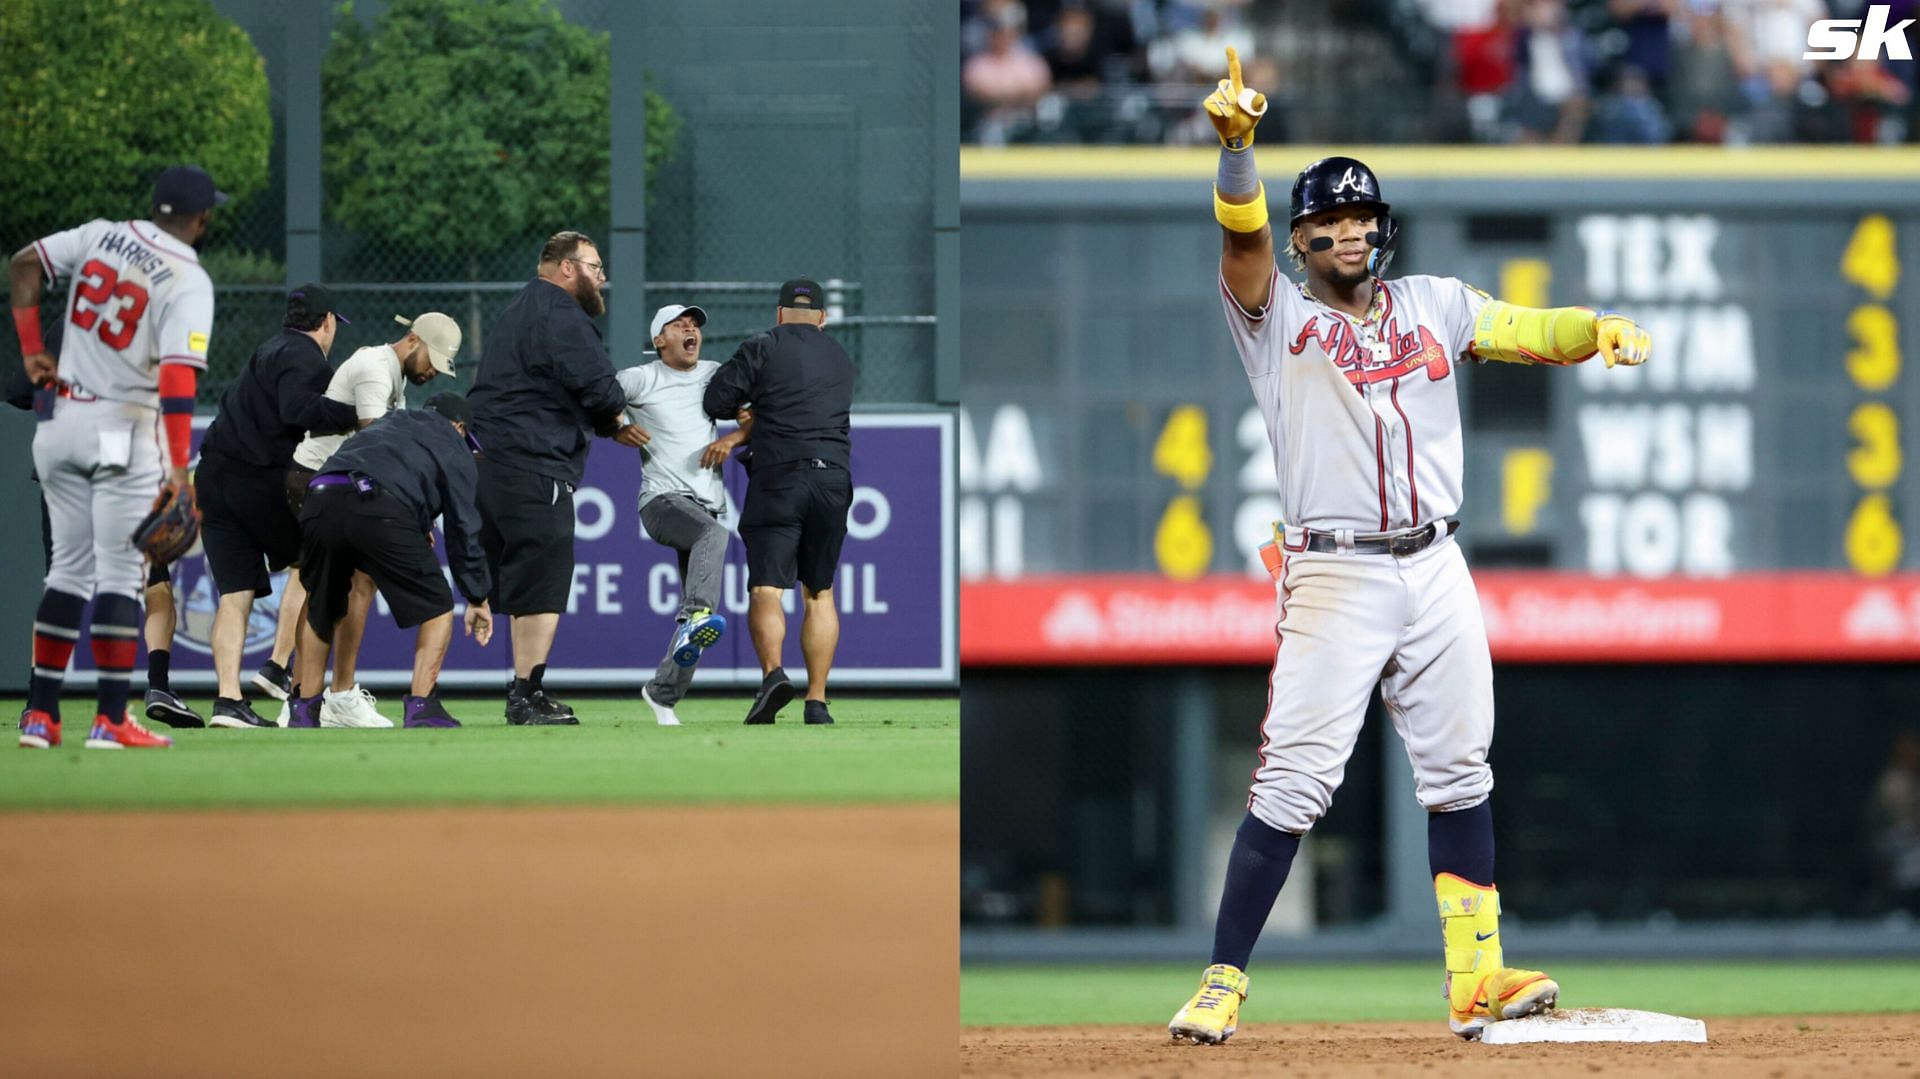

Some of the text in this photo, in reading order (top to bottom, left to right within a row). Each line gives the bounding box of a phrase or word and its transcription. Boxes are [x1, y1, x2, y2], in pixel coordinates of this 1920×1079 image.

[98, 231, 174, 287] HARRIS II
[1577, 214, 1900, 298] TEX 4
[70, 258, 149, 352] 23
[1289, 315, 1419, 368] Atlata
[1845, 304, 1901, 391] 3
[1154, 404, 1213, 490] 4
[1577, 403, 1902, 491] WSH 3
[1154, 495, 1214, 582] 6
[1579, 493, 1904, 580] TOR 6
